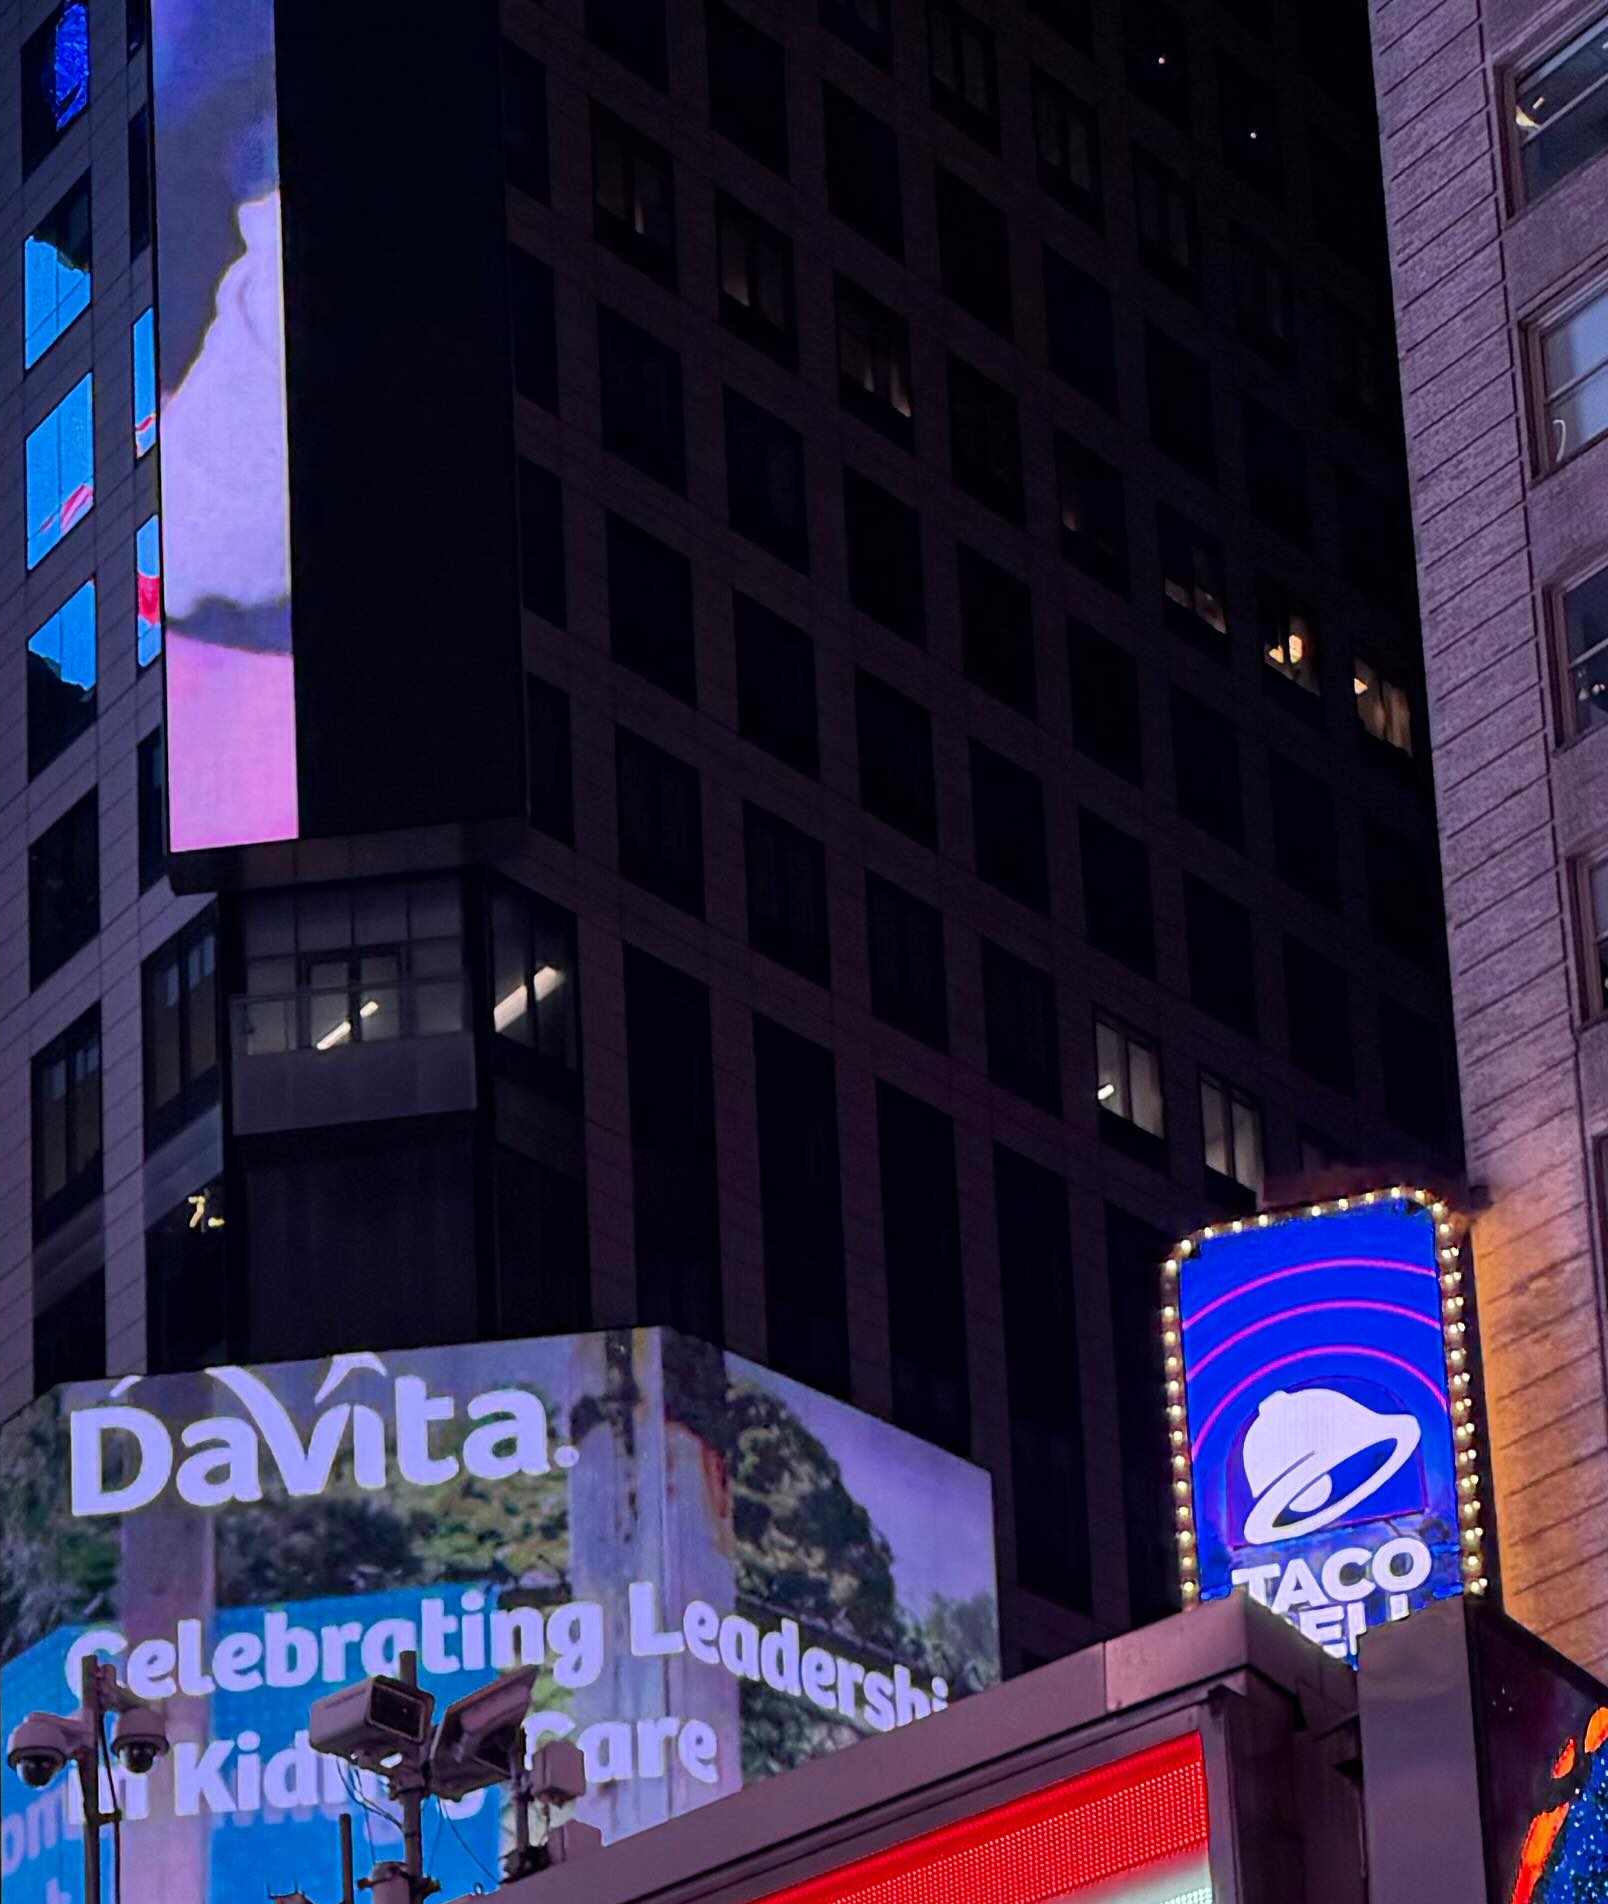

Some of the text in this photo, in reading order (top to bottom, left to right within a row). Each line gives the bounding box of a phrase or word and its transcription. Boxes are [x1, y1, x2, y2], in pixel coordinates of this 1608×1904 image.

[1232, 1537, 1432, 1614] TACO
[66, 1581, 949, 1732] Celebrating Leadershi
[174, 1731, 486, 1820] Kidn
[521, 1711, 719, 1784] Care
